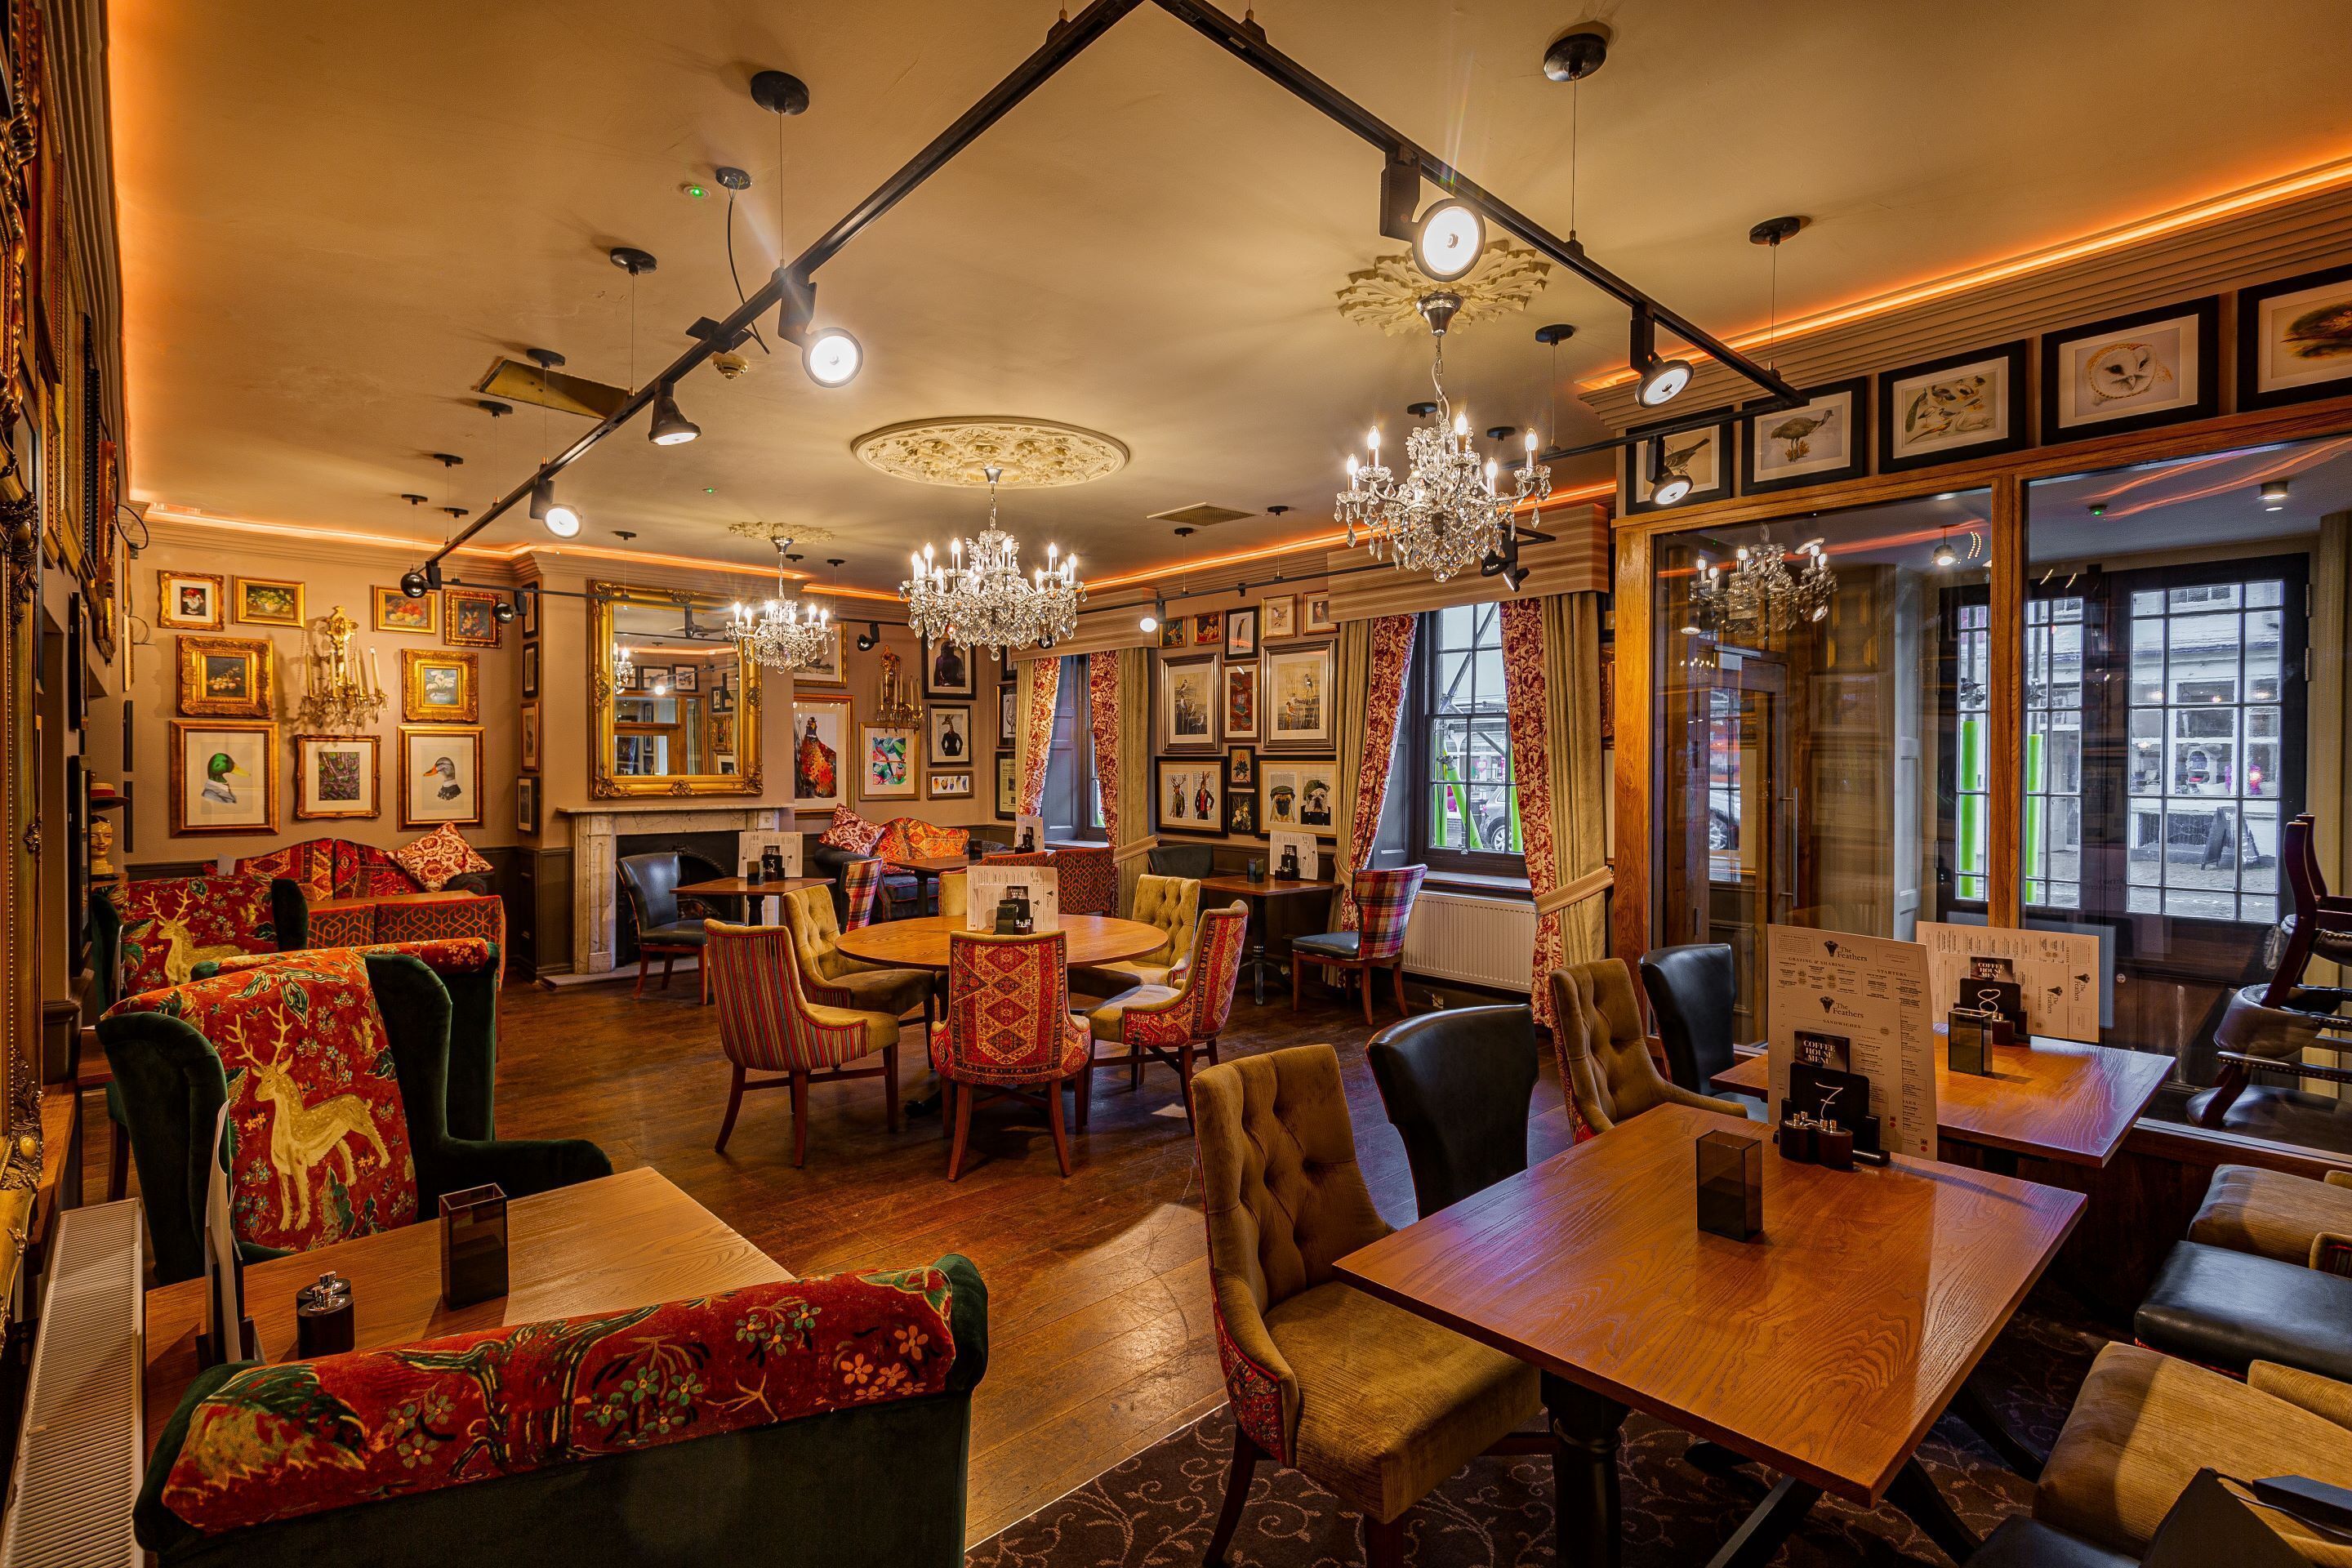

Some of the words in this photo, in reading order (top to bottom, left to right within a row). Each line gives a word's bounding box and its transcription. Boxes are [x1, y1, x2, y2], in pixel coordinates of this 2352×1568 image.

[1788, 956, 1812, 964] GRAZING
[1837, 951, 1869, 962] Feathers
[1977, 962, 2005, 970] COFFEE
[1979, 967, 2003, 975] HOUSE
[1877, 968, 1908, 978] STARTERS
[1835, 1001, 1849, 1010] The
[1977, 988, 2001, 1013] 8
[1833, 1007, 1864, 1019] Feathers
[1822, 1018, 1862, 1029] SANDWICHES
[1803, 1040, 1836, 1053] COFFEE
[1805, 1046, 1834, 1059] HOUSE
[1807, 1054, 1833, 1065] MENU
[1815, 1081, 1844, 1119] 7
